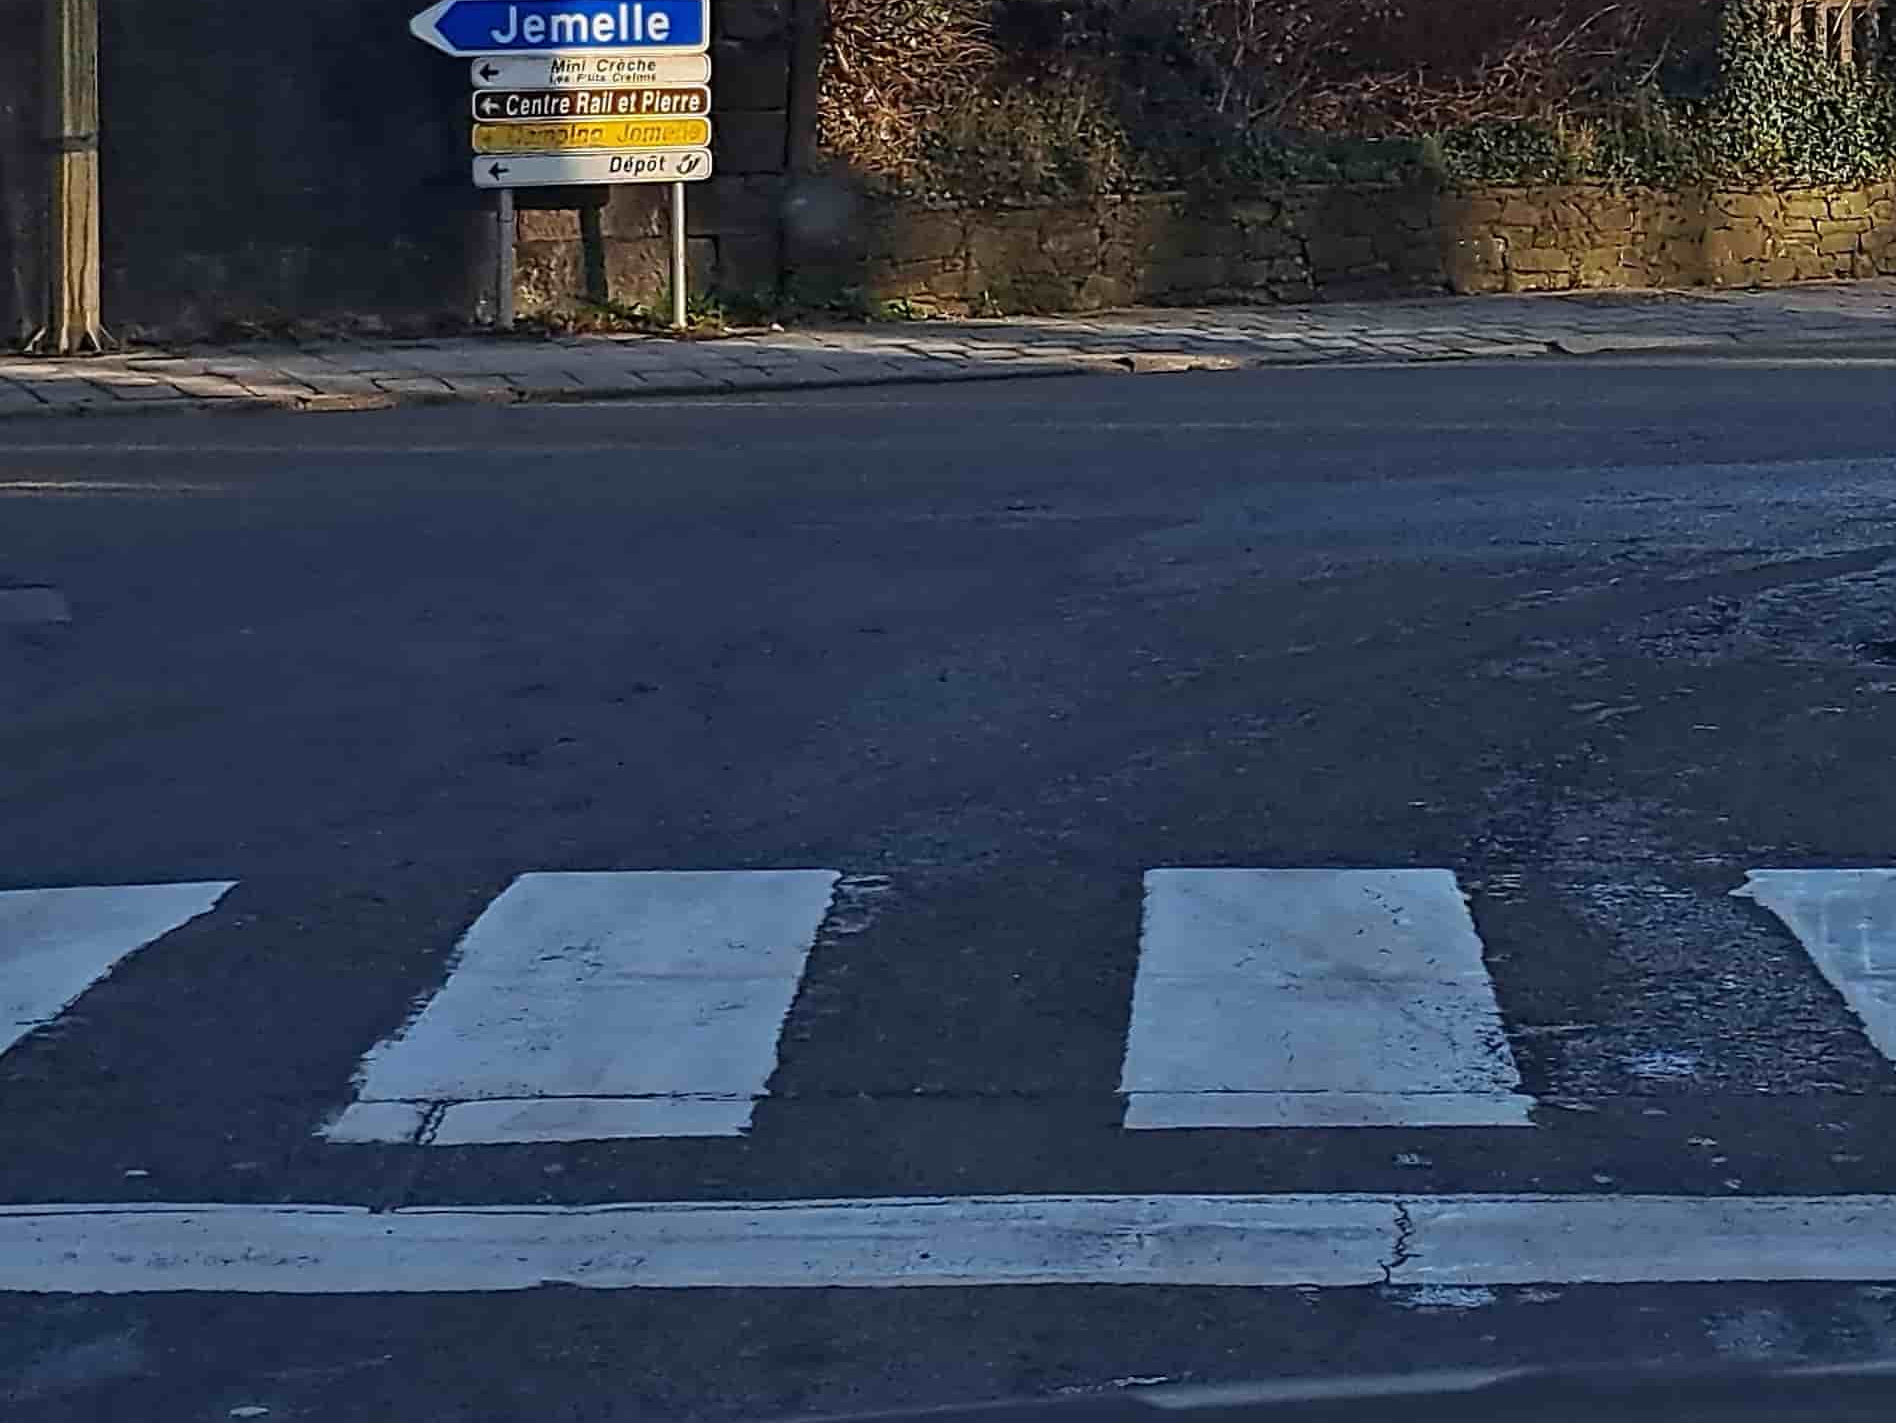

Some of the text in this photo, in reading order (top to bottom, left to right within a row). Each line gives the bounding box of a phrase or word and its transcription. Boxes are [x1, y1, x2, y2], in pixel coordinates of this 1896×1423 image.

[491, 3, 671, 44] Jemelle
[551, 58, 586, 72] Mini
[506, 90, 700, 116] Centre Rail et Pierre
[610, 155, 665, 176] Dépôt
